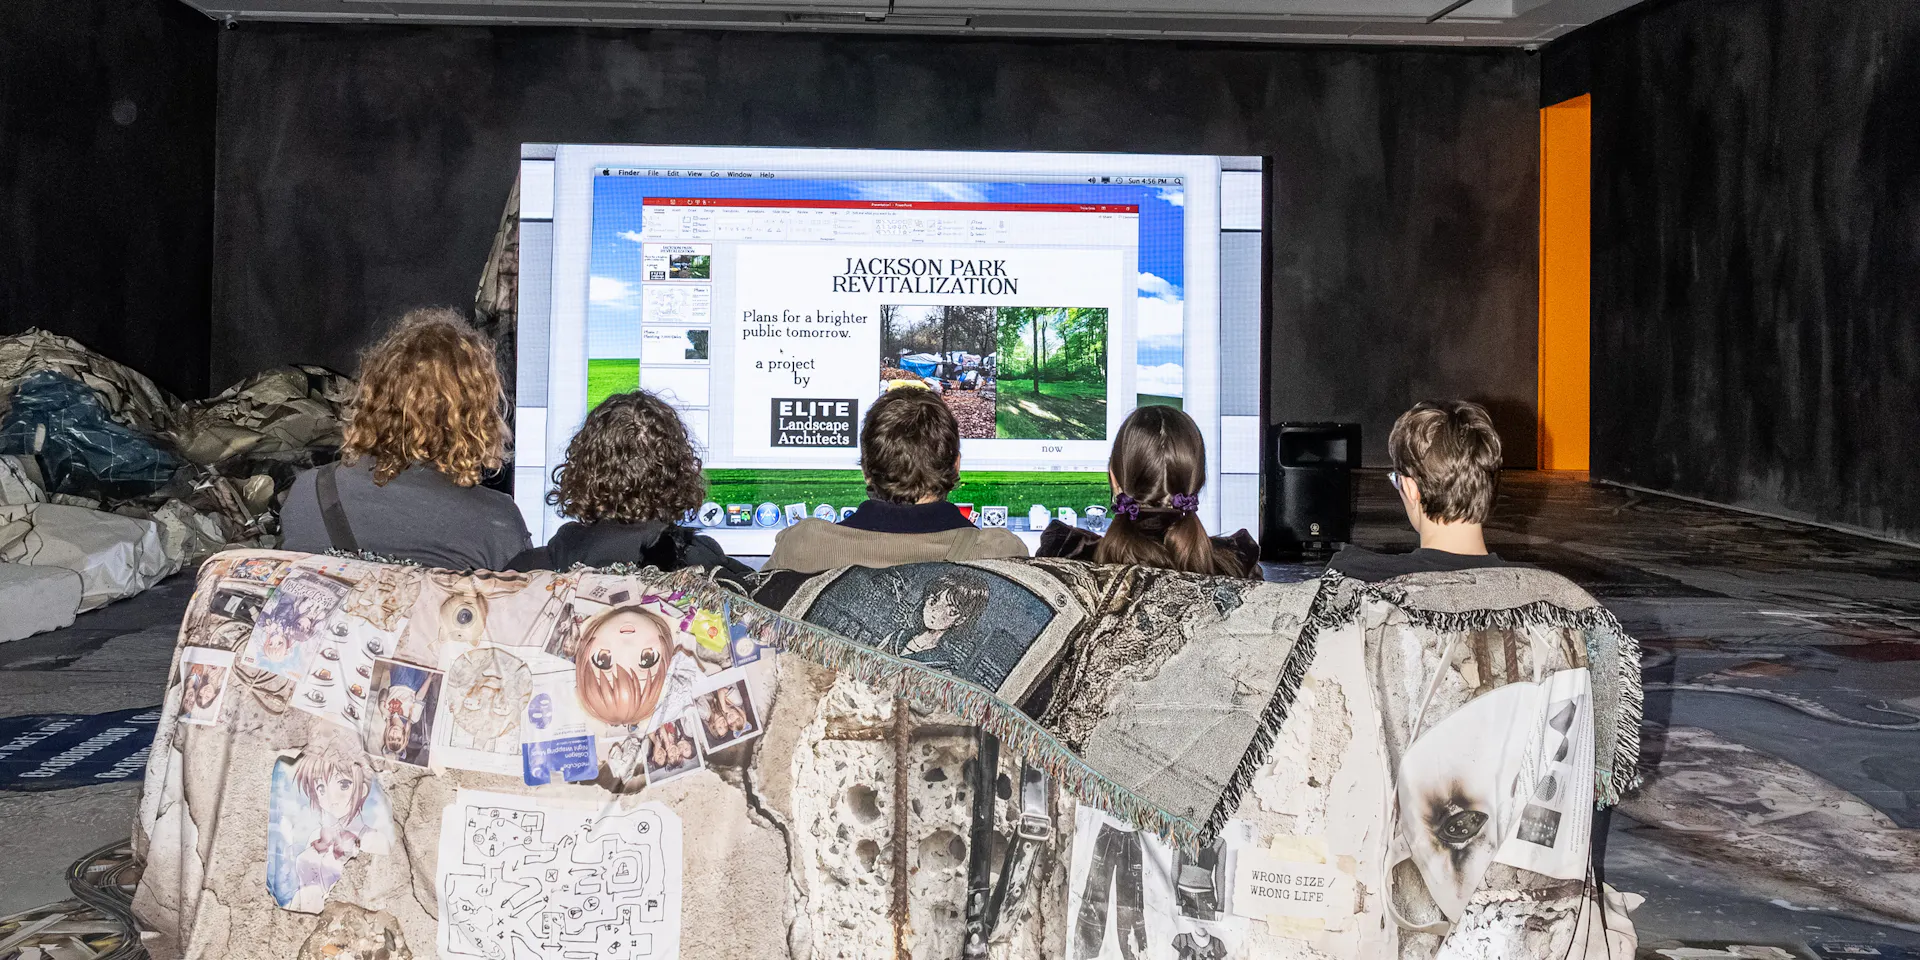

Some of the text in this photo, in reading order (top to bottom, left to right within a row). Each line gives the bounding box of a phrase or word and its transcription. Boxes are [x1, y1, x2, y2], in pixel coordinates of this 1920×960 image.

[844, 258, 1007, 277] JACKSON PARK
[832, 276, 1018, 295] REVITALIZATION
[743, 310, 867, 326] Plans for a brighter
[743, 325, 851, 340] public tomorrow.
[756, 356, 815, 373] a project
[794, 371, 810, 388] by
[779, 401, 849, 416] ELITE
[779, 417, 849, 435] Landscape
[778, 430, 850, 444] Architects
[1252, 870, 1336, 887] WRONG SIZE /
[1250, 885, 1324, 902] WRONG LIFE
